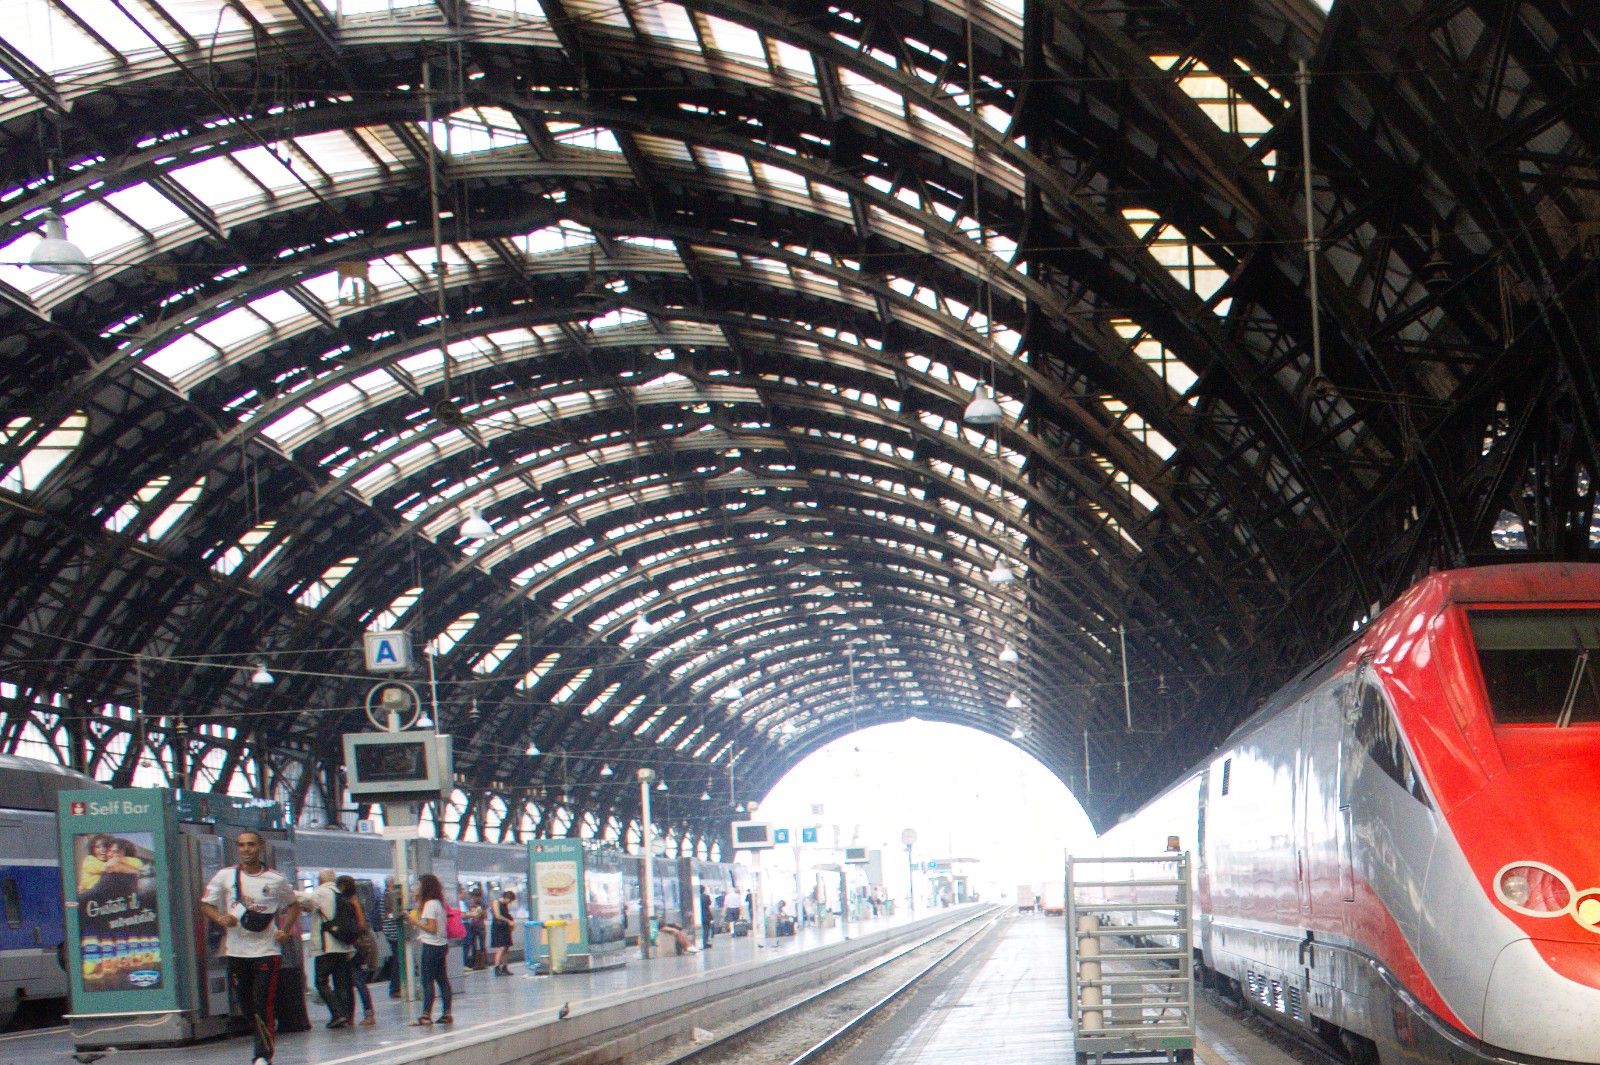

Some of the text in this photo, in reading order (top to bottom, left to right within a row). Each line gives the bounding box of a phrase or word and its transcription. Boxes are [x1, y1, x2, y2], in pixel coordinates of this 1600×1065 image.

[376, 640, 397, 663] A
[89, 800, 150, 816] Self Bar
[806, 831, 813, 841] 7
